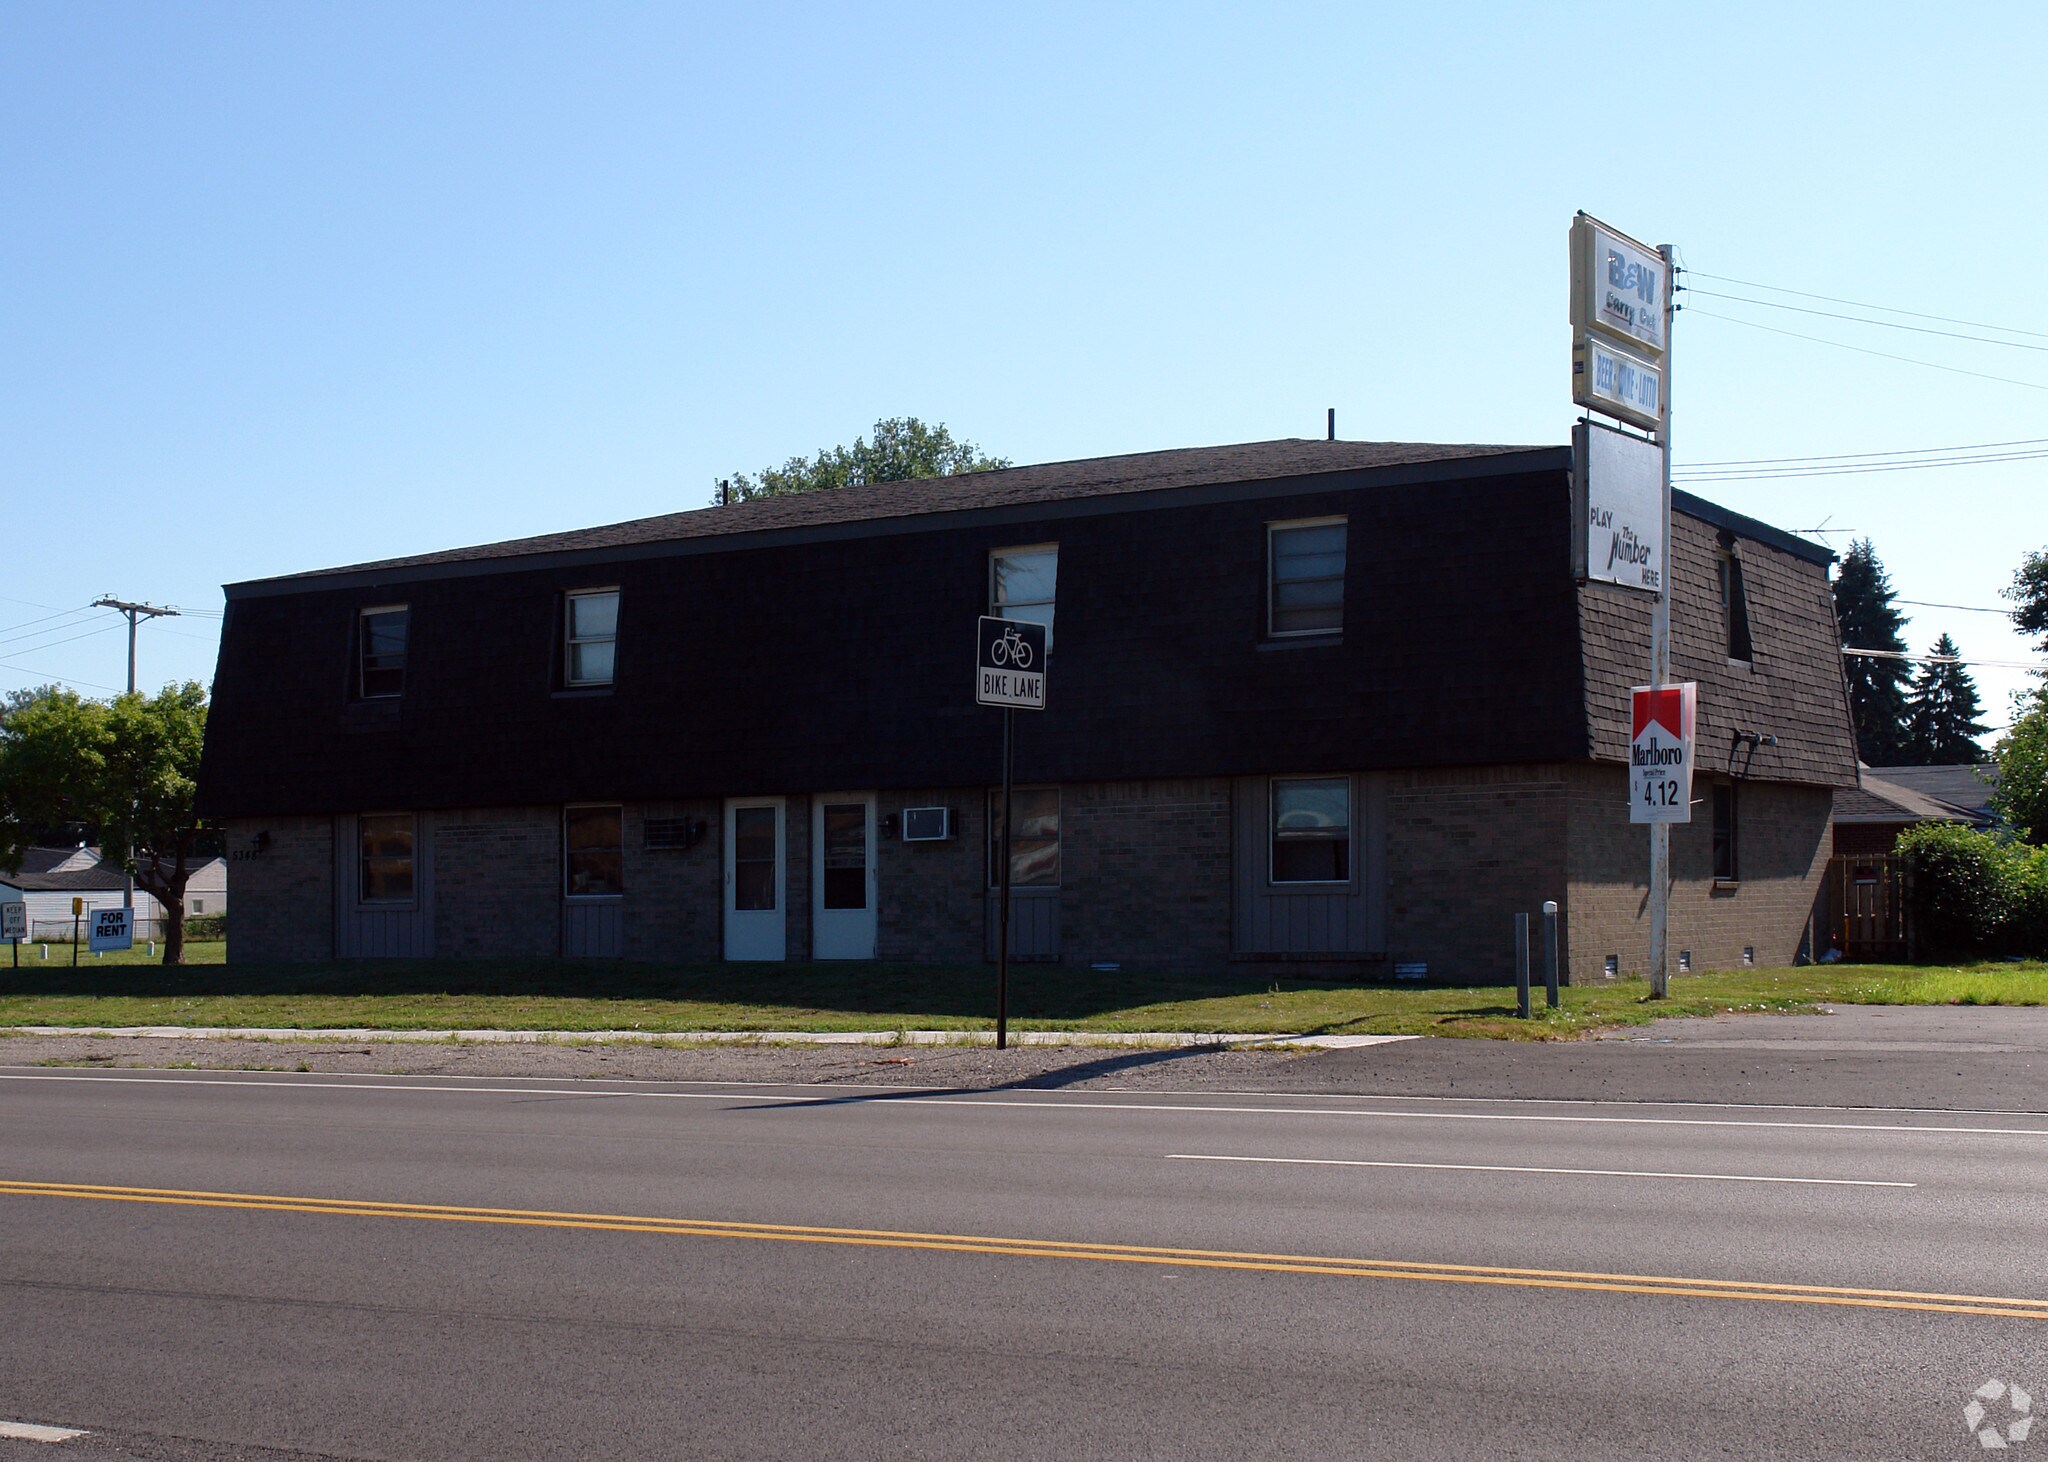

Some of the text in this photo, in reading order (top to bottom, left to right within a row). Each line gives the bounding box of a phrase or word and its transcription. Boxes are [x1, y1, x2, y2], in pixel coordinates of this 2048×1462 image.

[1609, 248, 1655, 305] B&W
[1606, 291, 1635, 326] Carry
[1597, 355, 1657, 409] BEER WINE LOTTO
[1590, 507, 1613, 529] PLAY
[1622, 526, 1633, 541] The
[1607, 531, 1650, 570] Number
[1642, 568, 1659, 587] HERE
[984, 674, 1040, 699] BIKE LANE
[1632, 737, 1682, 766] Marlboro
[1644, 780, 1678, 806] 4.12
[96, 924, 127, 937] RENT
[101, 912, 124, 924] FOR
